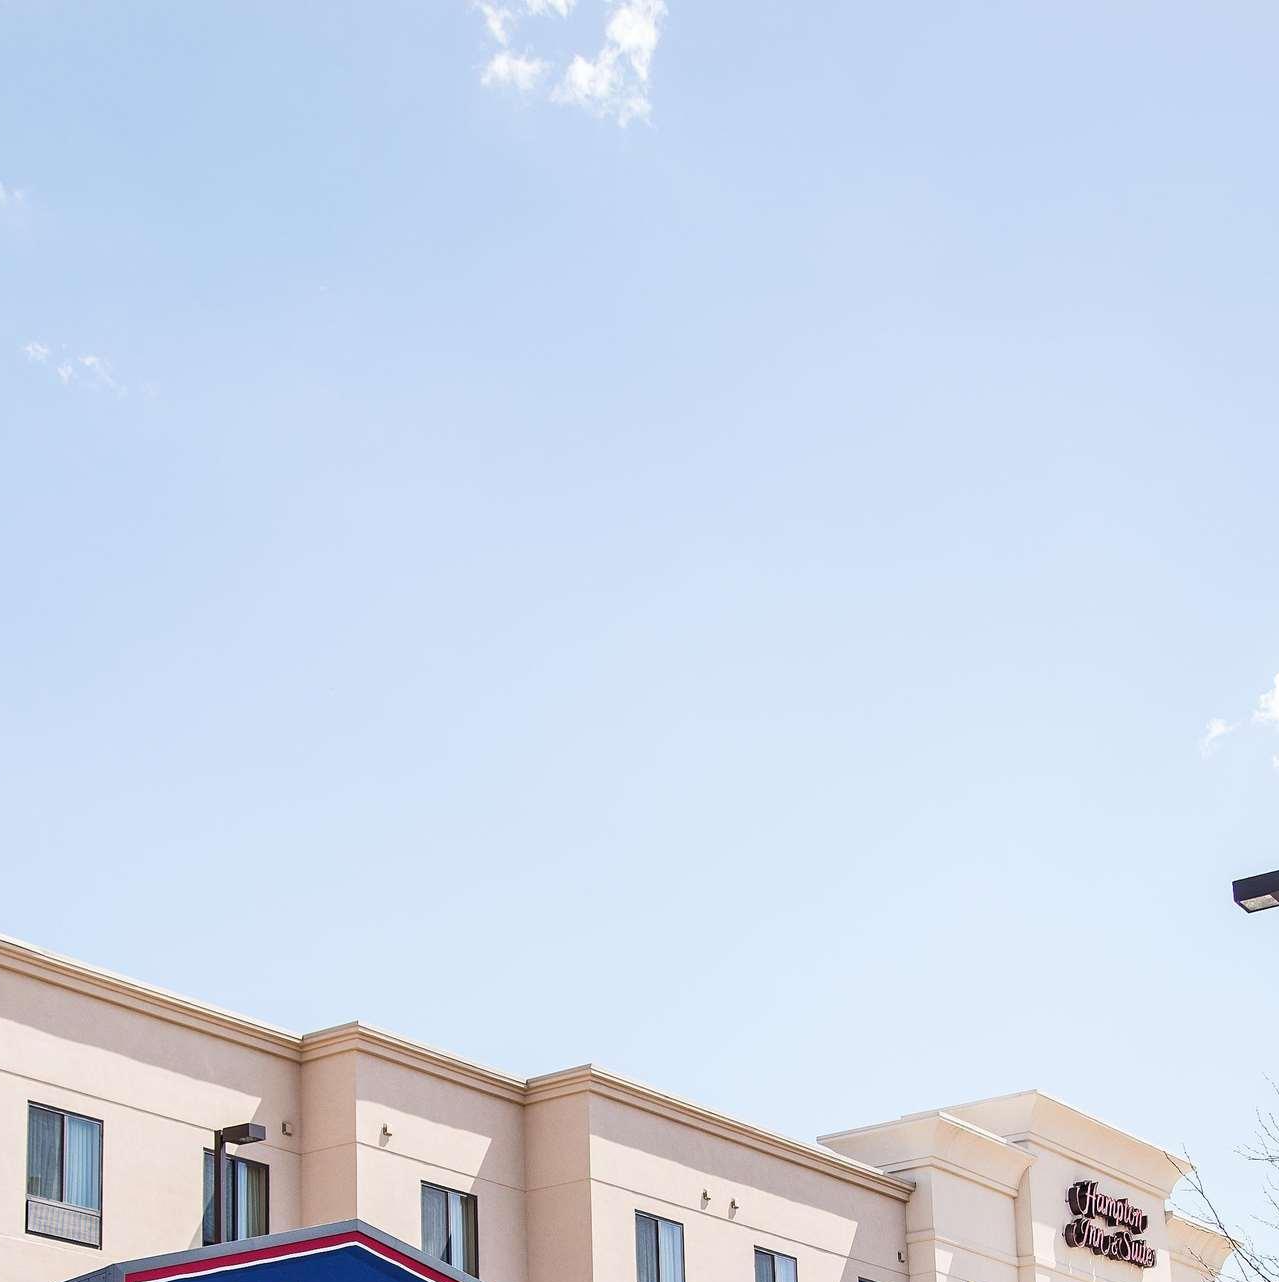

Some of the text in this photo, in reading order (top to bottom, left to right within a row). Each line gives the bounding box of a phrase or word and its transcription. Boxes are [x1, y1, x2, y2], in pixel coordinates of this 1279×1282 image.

[1066, 1180, 1148, 1235] Hampton
[1065, 1217, 1112, 1256] Inn
[1116, 1231, 1156, 1268] Suites
